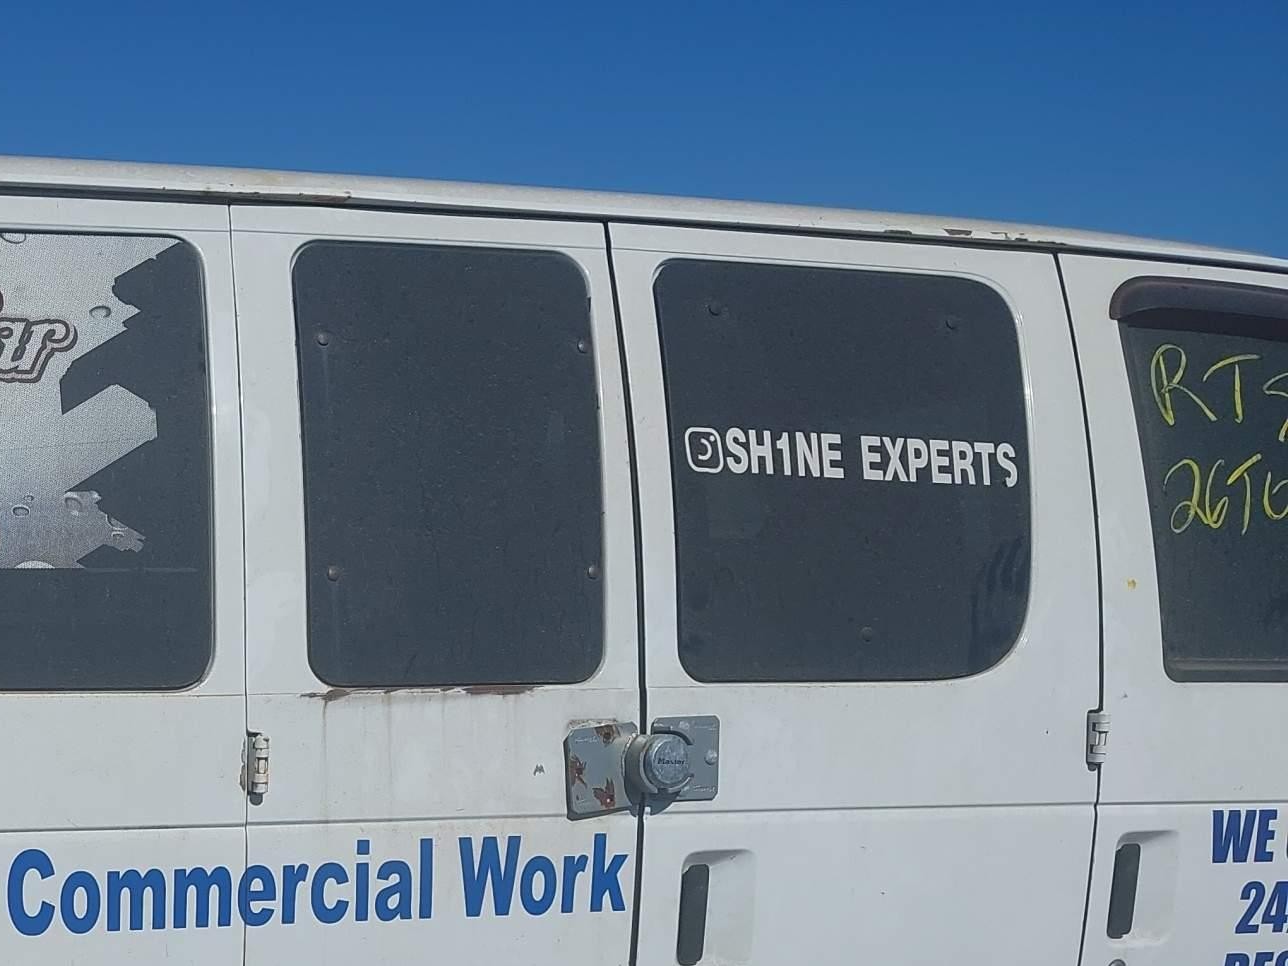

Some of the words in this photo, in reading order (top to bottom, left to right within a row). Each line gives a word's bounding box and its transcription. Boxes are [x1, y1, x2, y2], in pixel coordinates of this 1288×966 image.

[860, 435, 1018, 488] EXPERTS
[1211, 809, 1278, 864] WE
[6, 838, 434, 937] Commercial
[458, 832, 630, 918] Work
